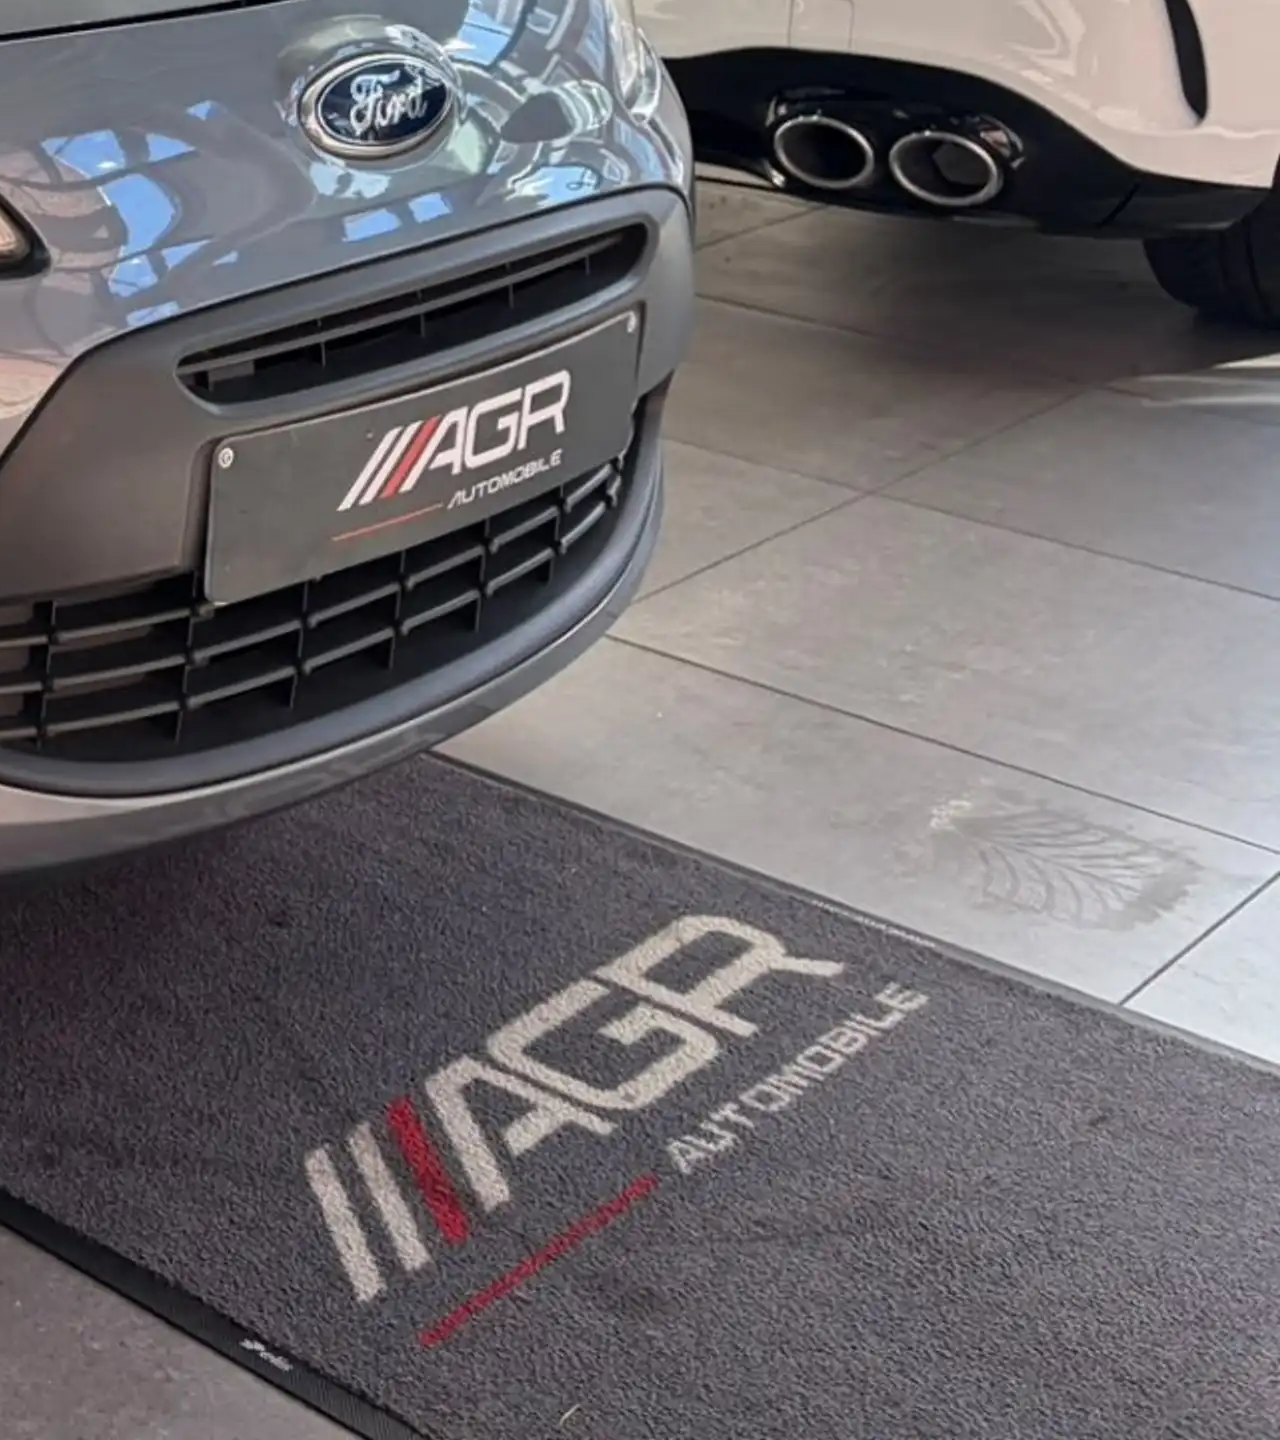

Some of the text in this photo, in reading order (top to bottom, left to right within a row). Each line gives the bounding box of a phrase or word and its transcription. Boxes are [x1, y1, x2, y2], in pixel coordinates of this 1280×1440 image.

[350, 69, 428, 137] Ford
[398, 369, 571, 494] AGR
[447, 448, 564, 510] AUTOMOBILE
[424, 913, 844, 1212] AGR
[666, 980, 930, 1175] AUTOMOBILE
